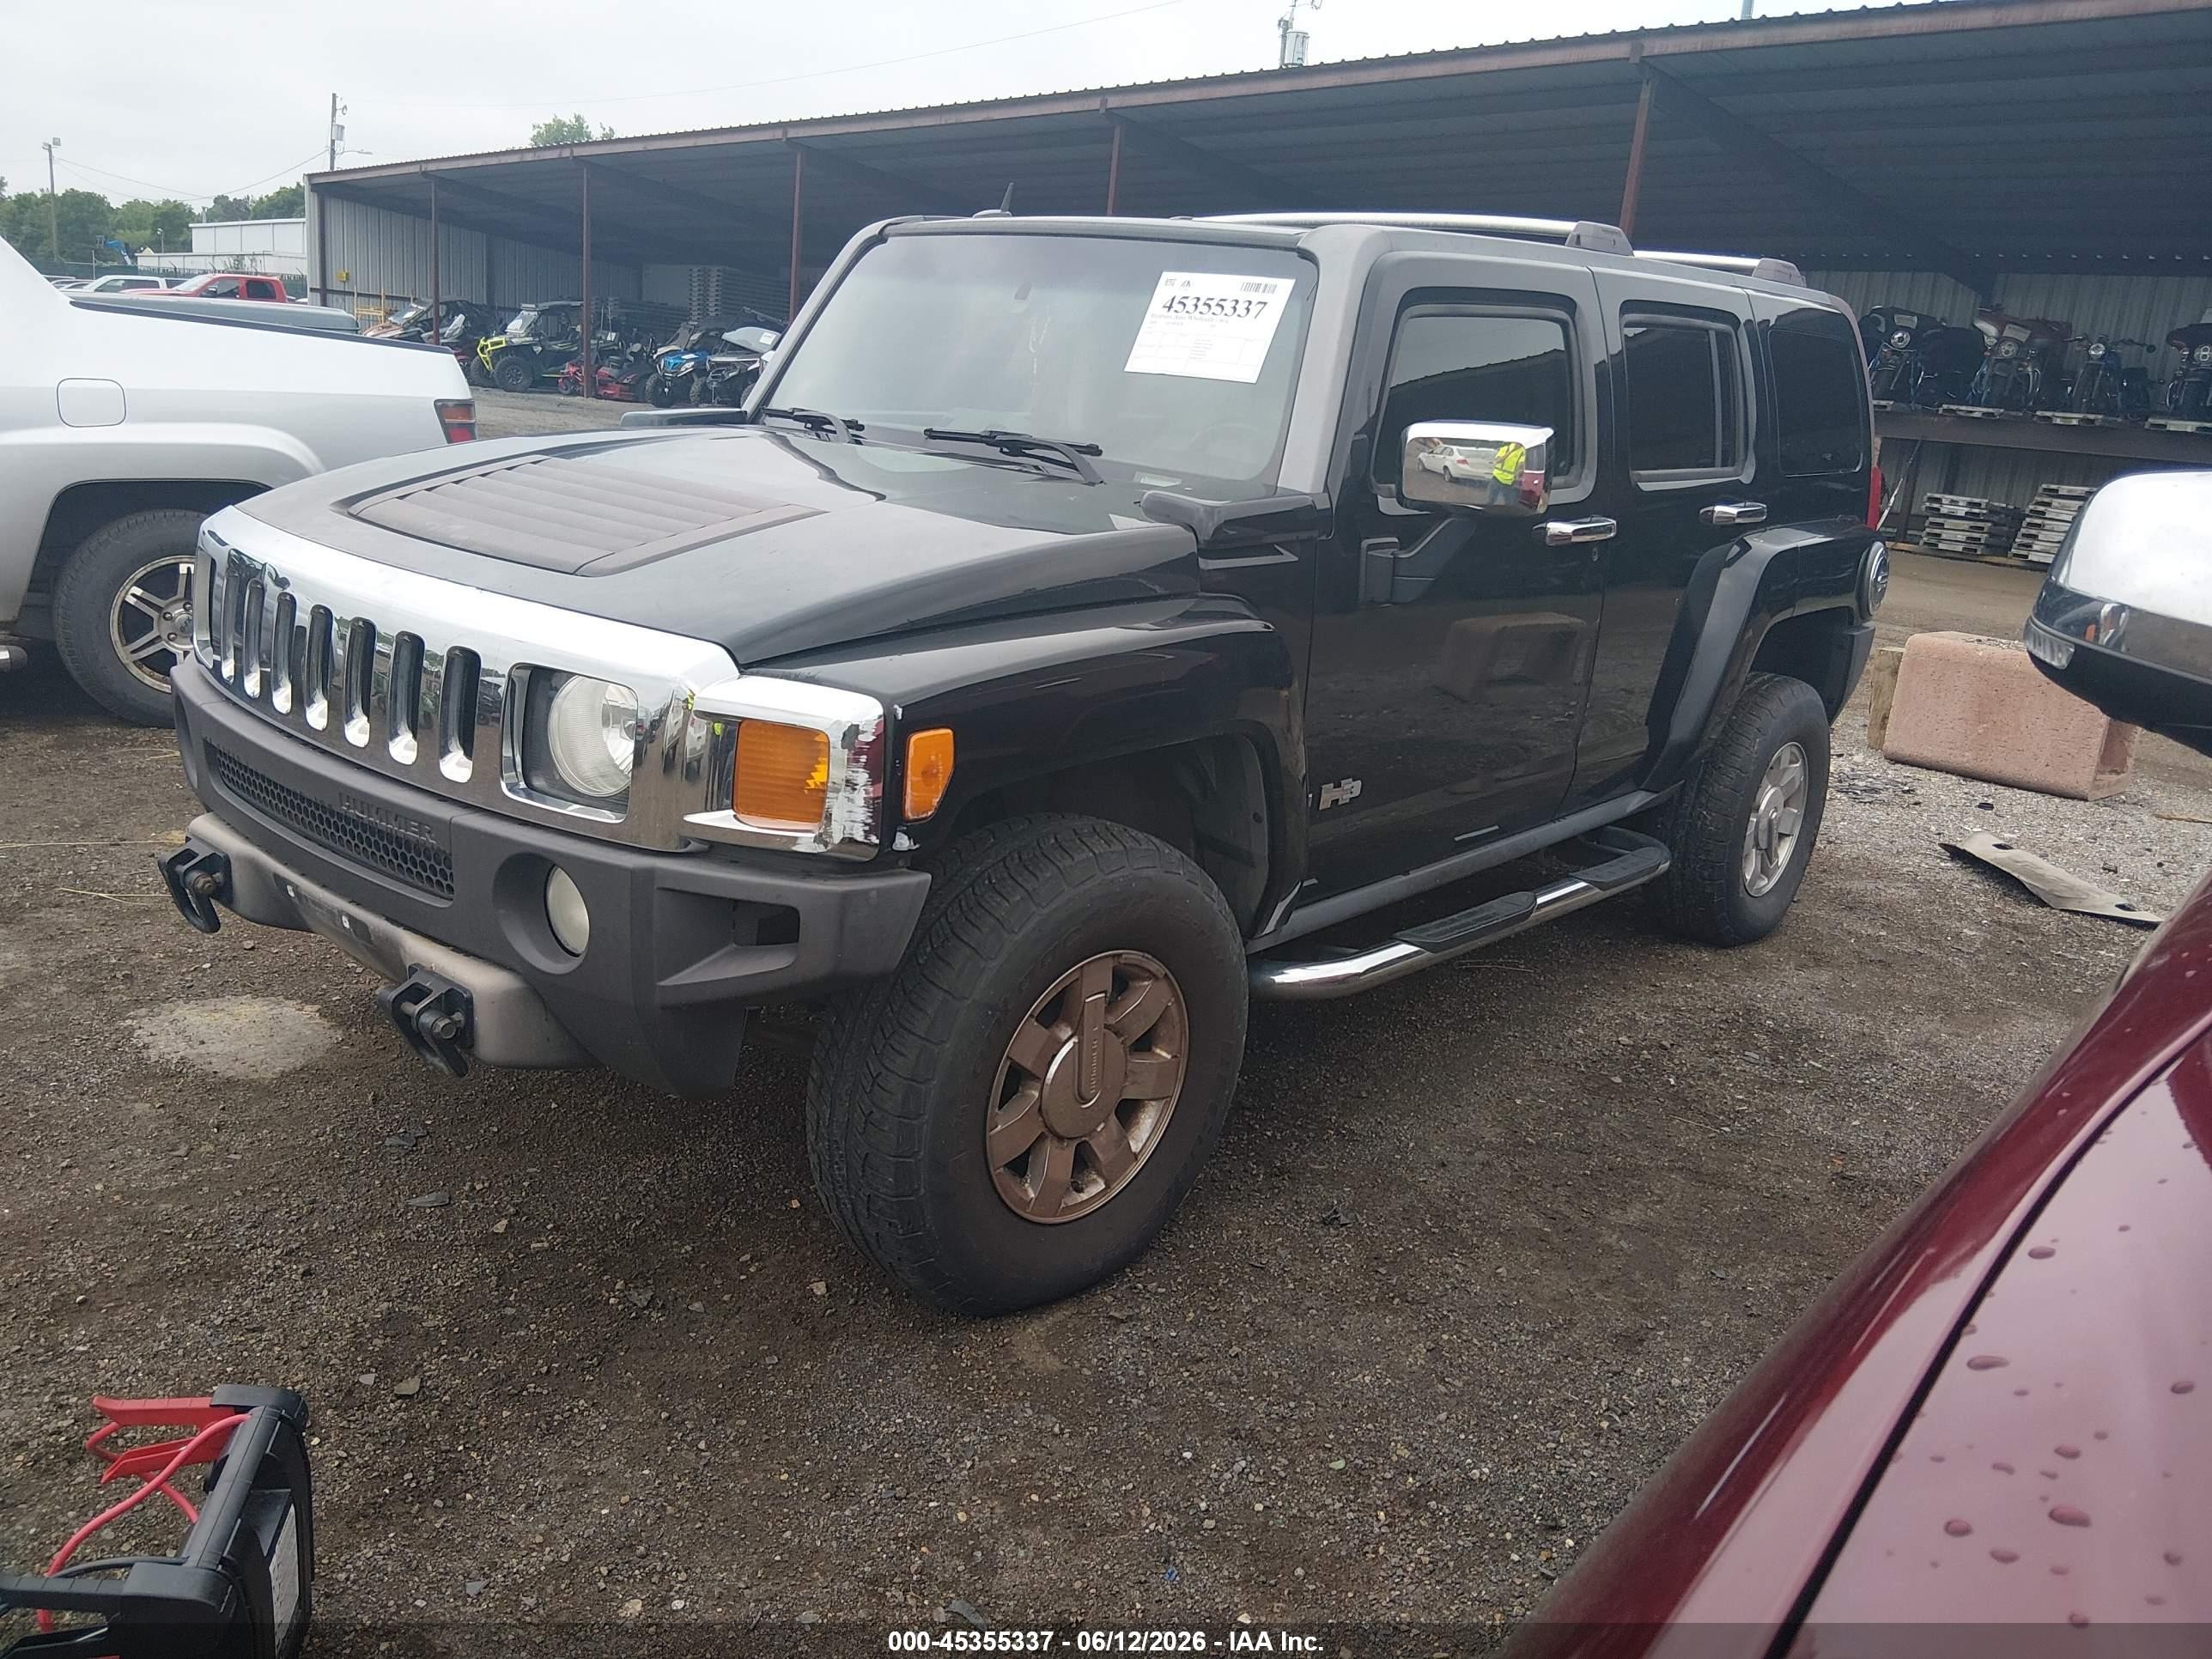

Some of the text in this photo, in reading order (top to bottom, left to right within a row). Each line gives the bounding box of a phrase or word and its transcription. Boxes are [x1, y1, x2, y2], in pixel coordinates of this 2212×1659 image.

[1162, 295, 1268, 319] 45355337
[1319, 778, 1362, 811] H3
[339, 792, 438, 845] HUMMER
